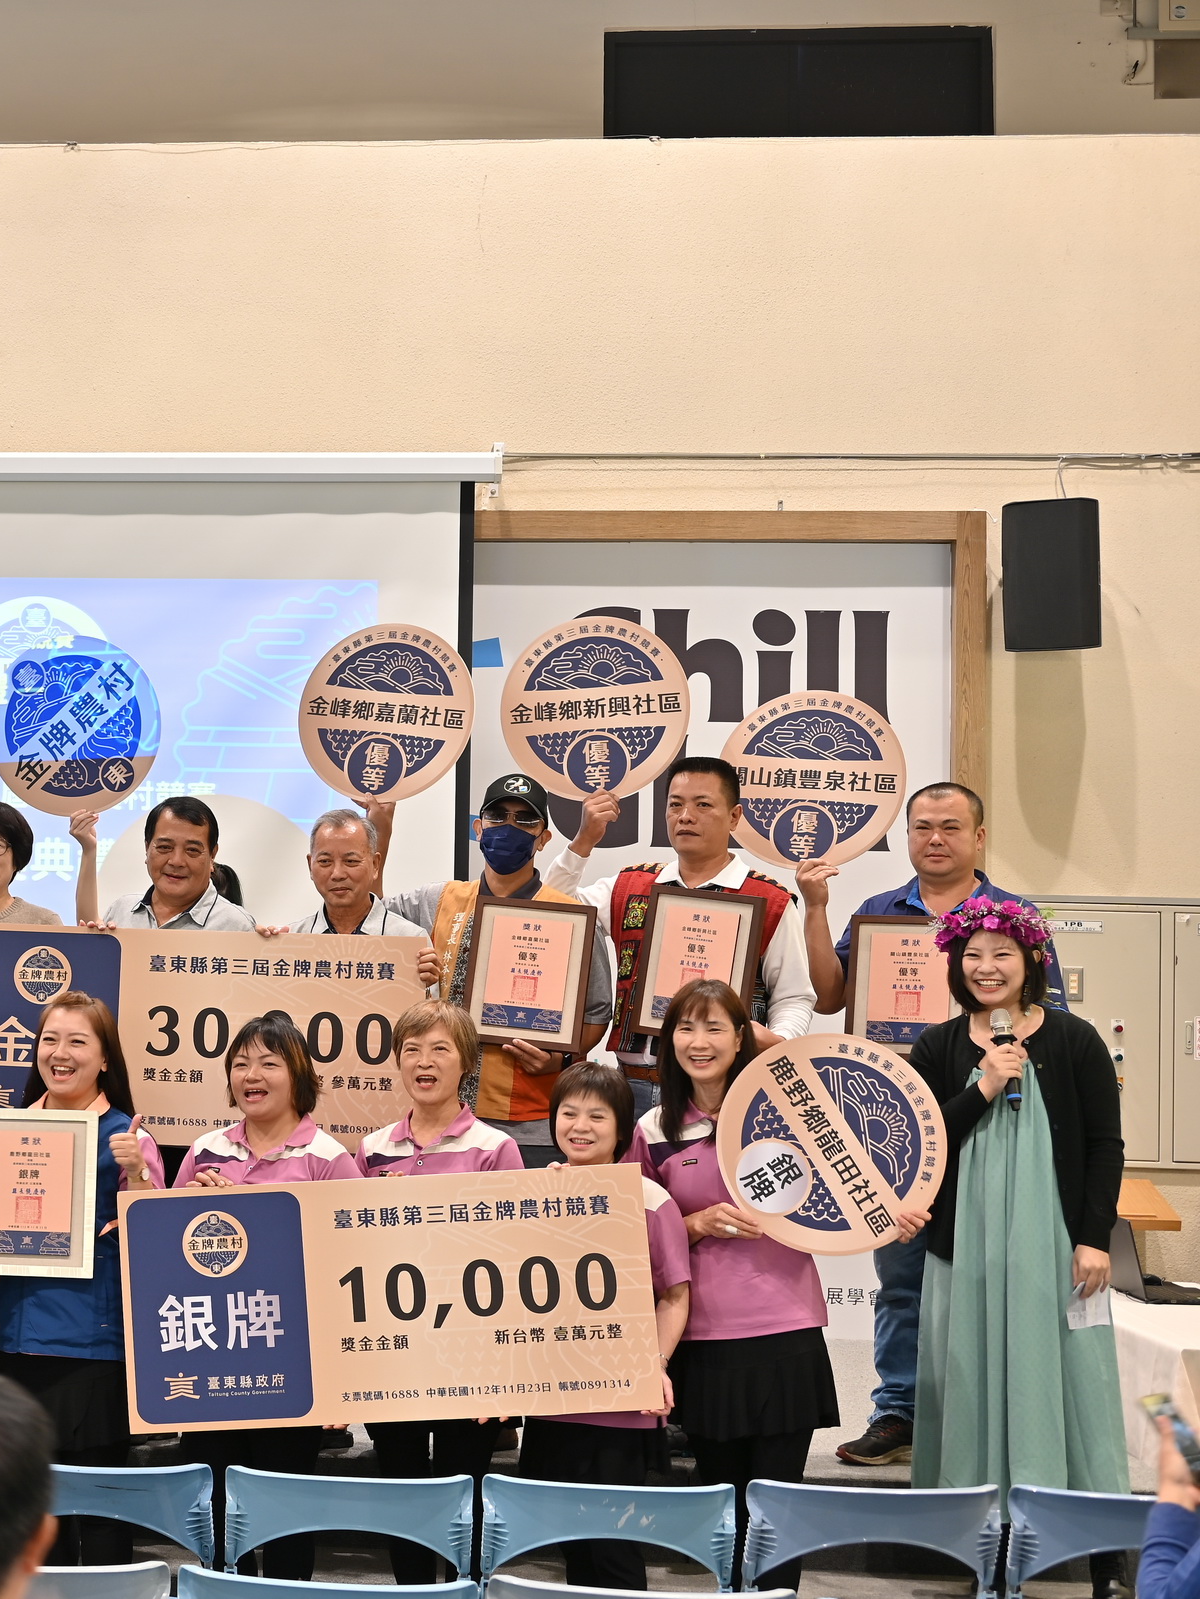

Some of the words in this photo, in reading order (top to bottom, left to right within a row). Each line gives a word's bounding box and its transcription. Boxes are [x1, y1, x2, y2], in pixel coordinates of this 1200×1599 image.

[332, 630, 459, 674] 臺東縣第三屆金牌農村競賽
[524, 623, 662, 669] 臺東縣第三屆金牌農村競賽
[306, 695, 466, 730] 金峰鄉嘉蘭社區
[509, 692, 682, 725] 金峰鄉新興社區
[747, 698, 885, 739] 臺東縣第三屆金牌農村競賽
[14, 661, 136, 790] 金牌農村
[103, 760, 134, 791] 東
[360, 741, 391, 791] 優等
[582, 739, 611, 789] 優等
[788, 809, 819, 859] 優等
[446, 911, 466, 946] 理事長
[522, 922, 542, 932] 獎狀
[692, 913, 711, 923] 獎狀
[517, 950, 538, 962] 優等
[687, 942, 706, 955] 優等
[900, 938, 921, 947] 獎狀
[17, 968, 68, 982] 金牌農村
[148, 953, 396, 981] 臺東縣第三屆金牌農村競賽
[898, 966, 919, 977] 優等
[142, 1067, 204, 1084] 獎金金額
[331, 1074, 393, 1092] 參萬元整
[837, 1042, 938, 1185] 臺東縣第三屆金牌農村競賽
[20, 1136, 42, 1146] 獎狀
[766, 1054, 896, 1239] 鹿野鄉龍田社區
[18, 1168, 40, 1180] 銀牌
[738, 1152, 805, 1204] 銀牌
[333, 1194, 611, 1231] 臺東縣第三屆金牌農村競賽
[187, 1236, 244, 1252] 金牌農村
[338, 1252, 618, 1330] 10,000
[157, 1289, 285, 1353] 銀牌
[340, 1333, 410, 1354] 獎金金額
[493, 1326, 547, 1346] 新台幣
[552, 1323, 624, 1342] 壹萬元整
[207, 1372, 286, 1391] 臺東縣政府
[208, 1390, 230, 1398] Taitung
[230, 1390, 251, 1398] County
[251, 1388, 286, 1396] Government
[341, 1387, 420, 1404] 支票號碼16888
[425, 1381, 552, 1399] 中華民國112年11月23日
[557, 1377, 632, 1392] 帳號0891314
